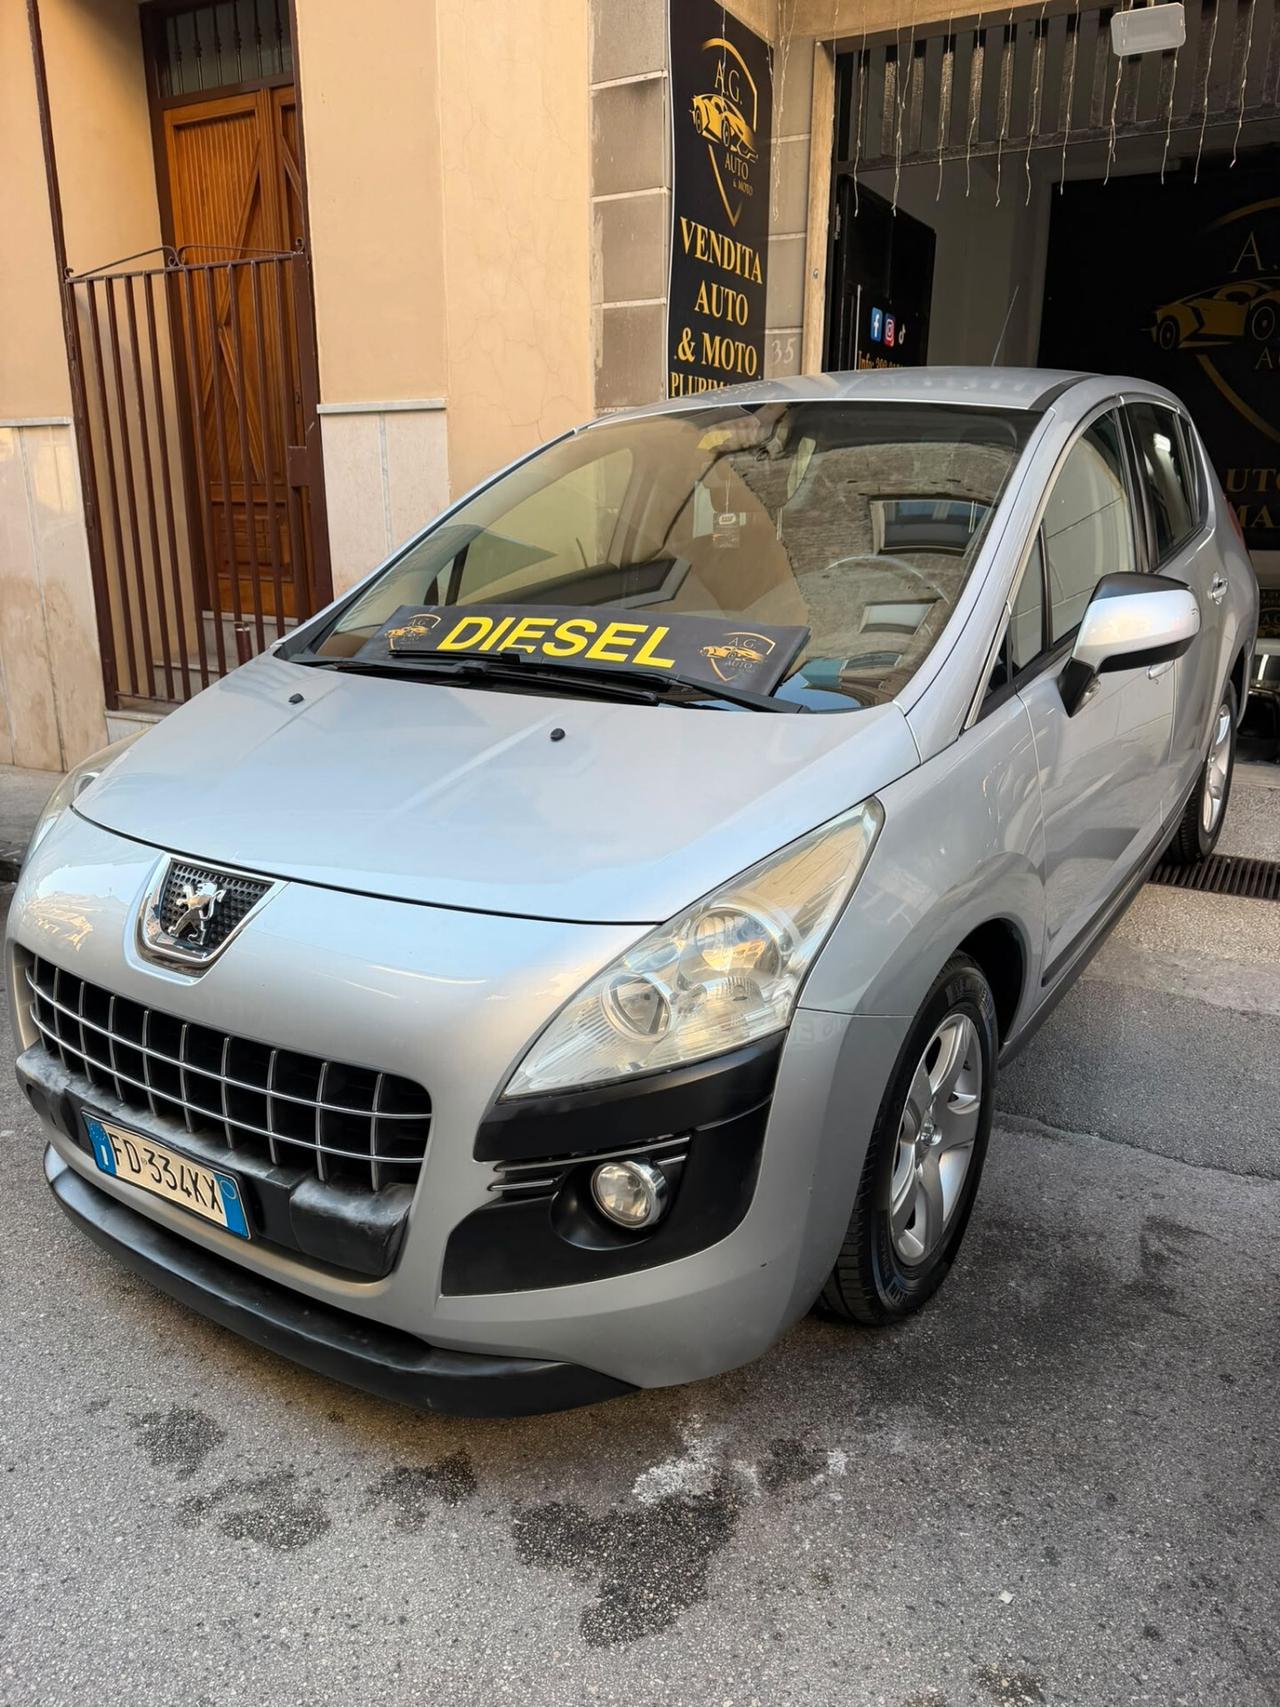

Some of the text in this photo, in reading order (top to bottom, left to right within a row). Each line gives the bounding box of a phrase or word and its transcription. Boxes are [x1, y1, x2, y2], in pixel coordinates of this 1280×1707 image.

[725, 153, 749, 181] AUTO
[680, 216, 764, 285] VENDITA
[694, 279, 749, 326] AUTO
[677, 327, 758, 377] & MOTO
[772, 337, 797, 364] 35
[436, 616, 676, 669] DIESEL
